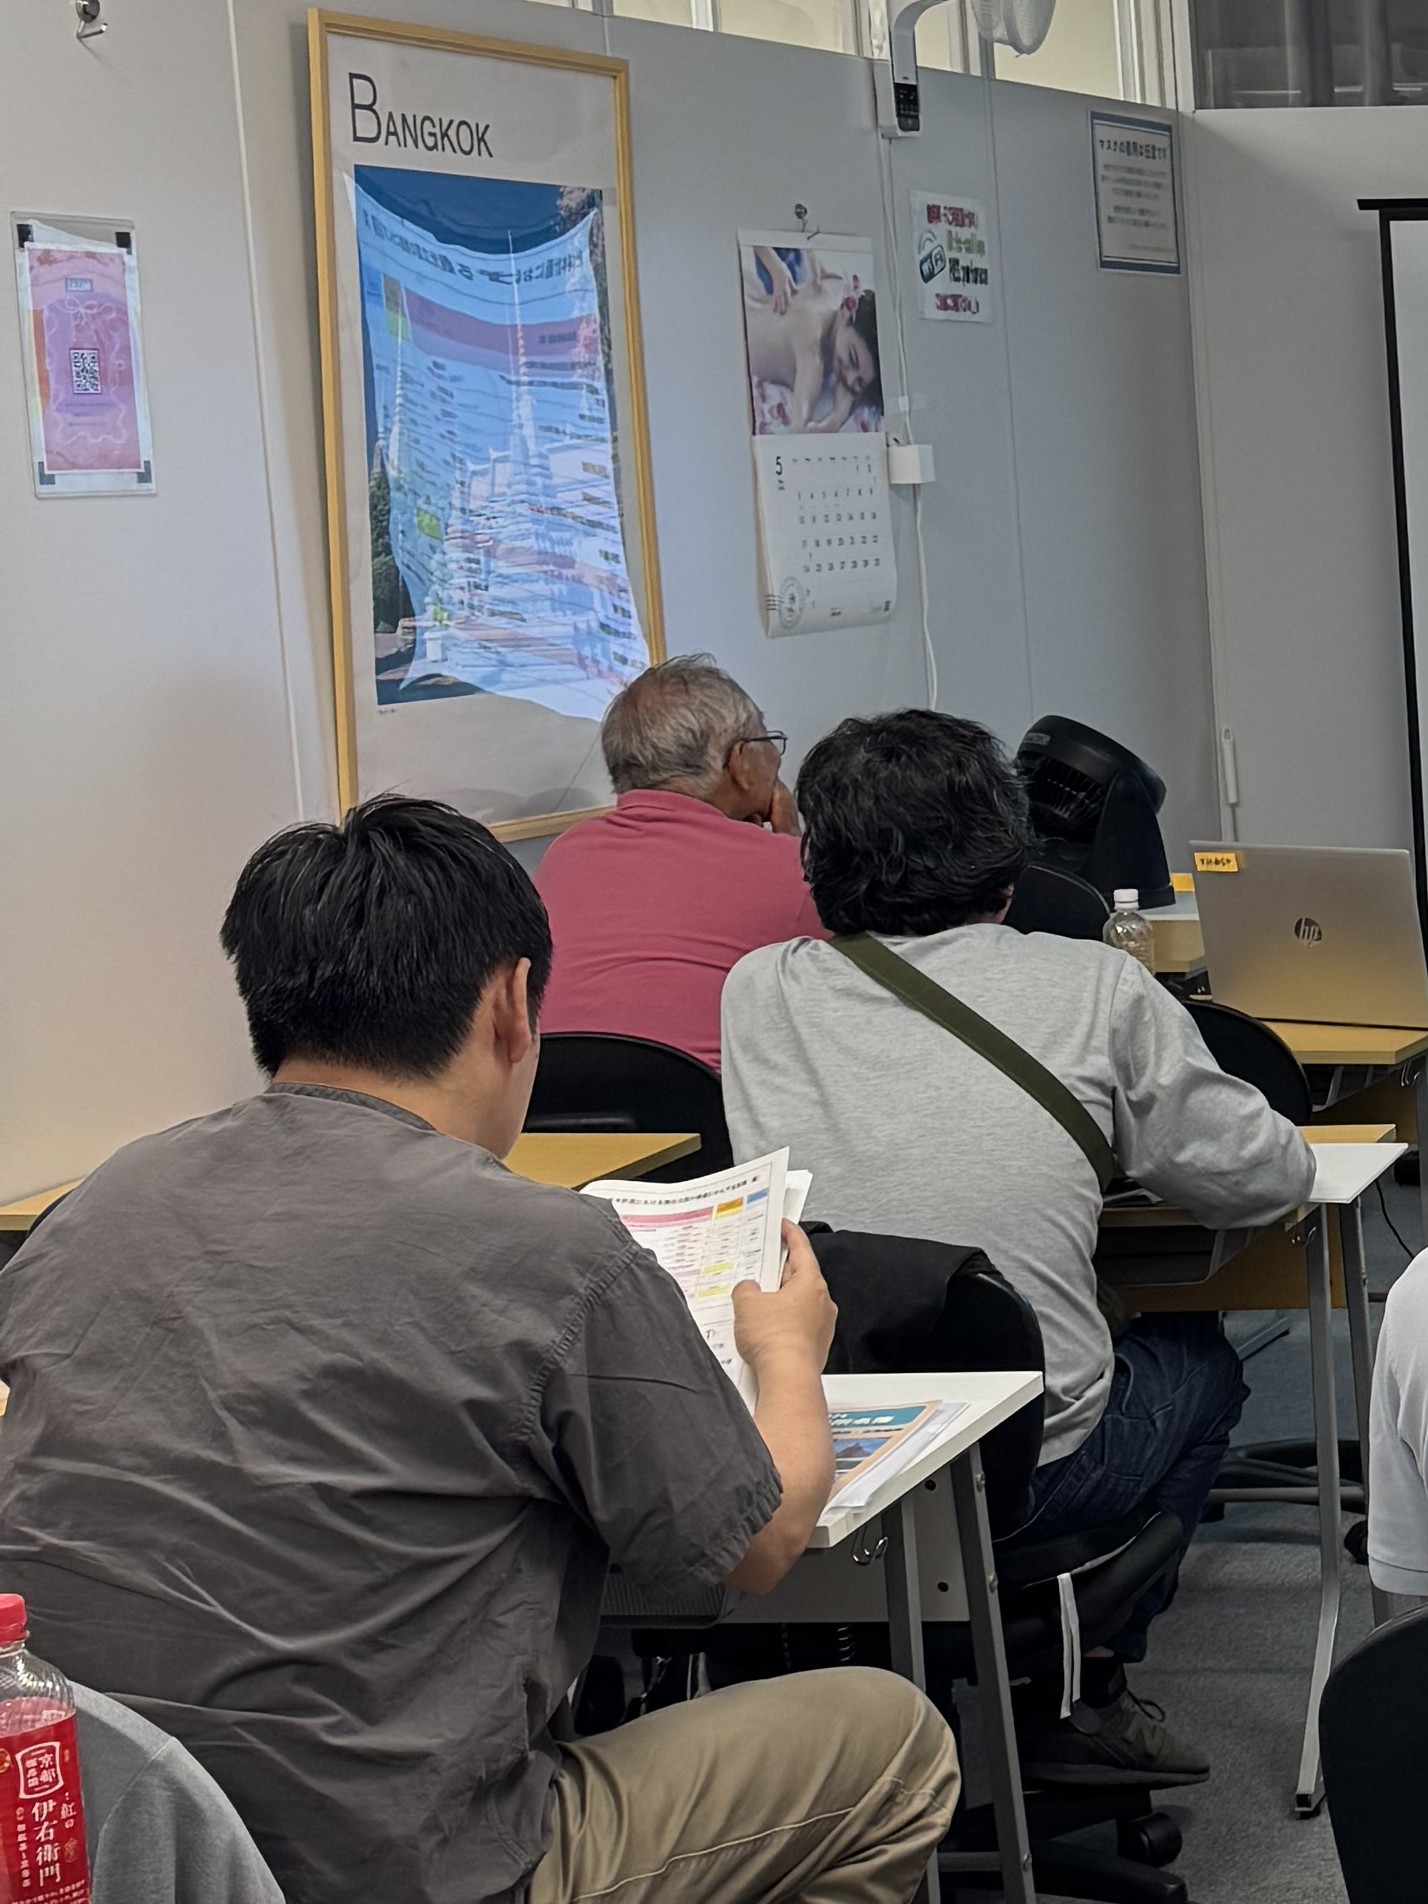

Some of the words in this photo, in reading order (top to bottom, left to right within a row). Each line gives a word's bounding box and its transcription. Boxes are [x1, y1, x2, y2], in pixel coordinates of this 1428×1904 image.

[347, 71, 494, 159] BANGKOK
[775, 456, 783, 476] 5
[1298, 916, 1321, 945] hp
[31, 1798, 62, 1887] 伊右衛門
